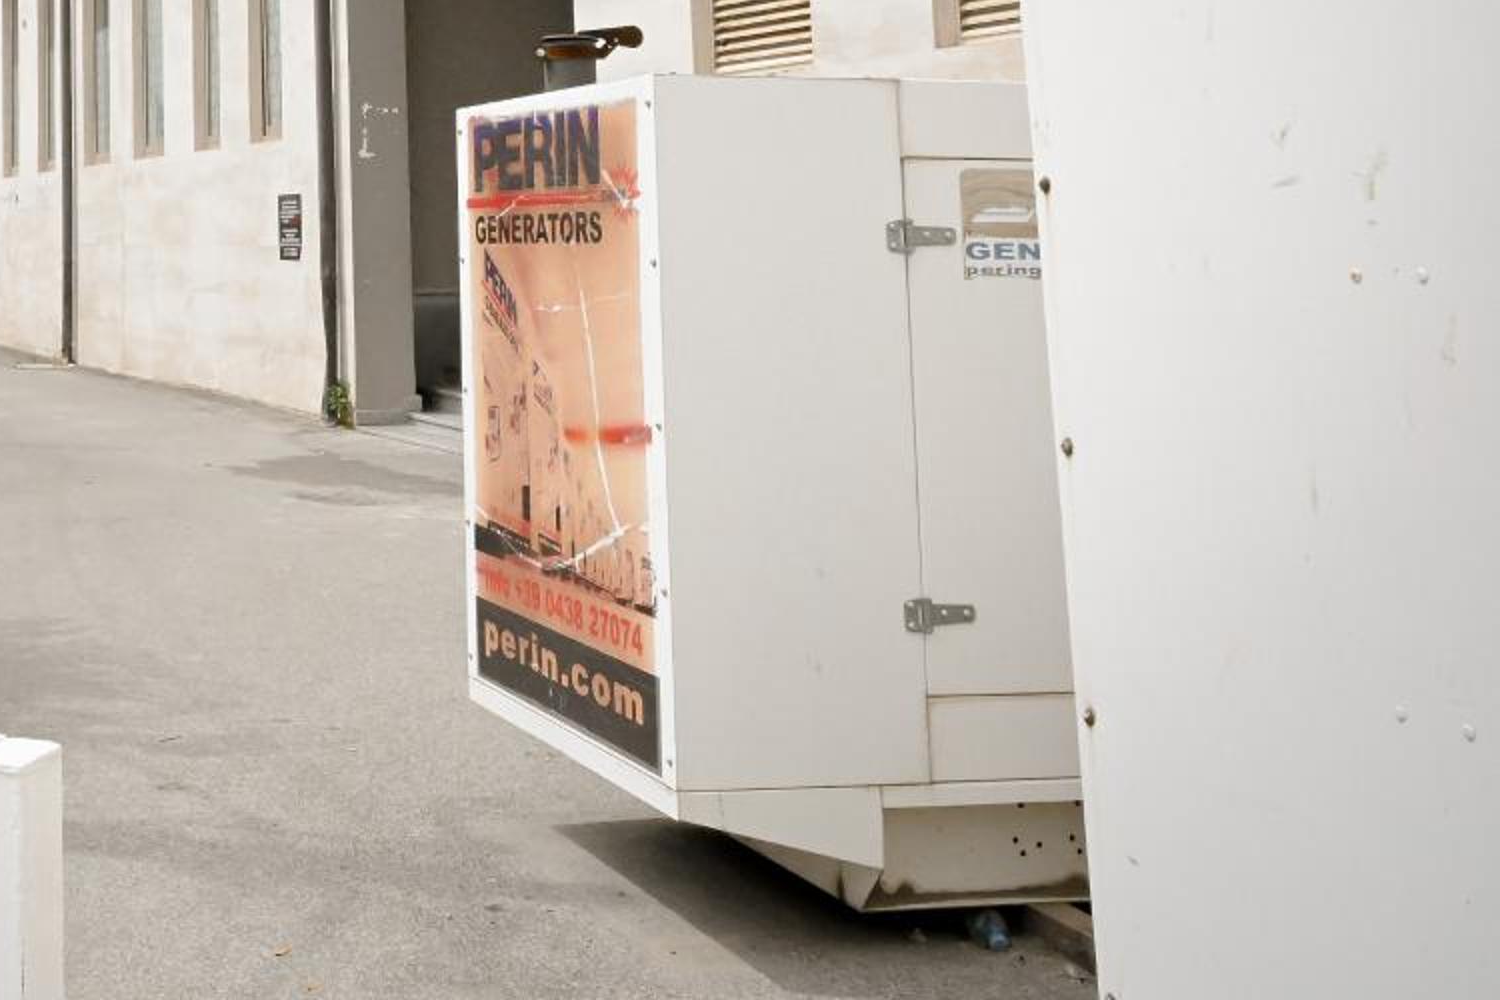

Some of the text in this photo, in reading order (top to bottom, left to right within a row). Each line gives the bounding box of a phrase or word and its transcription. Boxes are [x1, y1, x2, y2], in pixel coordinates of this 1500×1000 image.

[474, 105, 600, 192] PERIN
[475, 212, 603, 245] GENERATORS
[544, 590, 583, 633] 0438
[589, 604, 644, 656] 27074
[483, 619, 644, 725] perin.com
